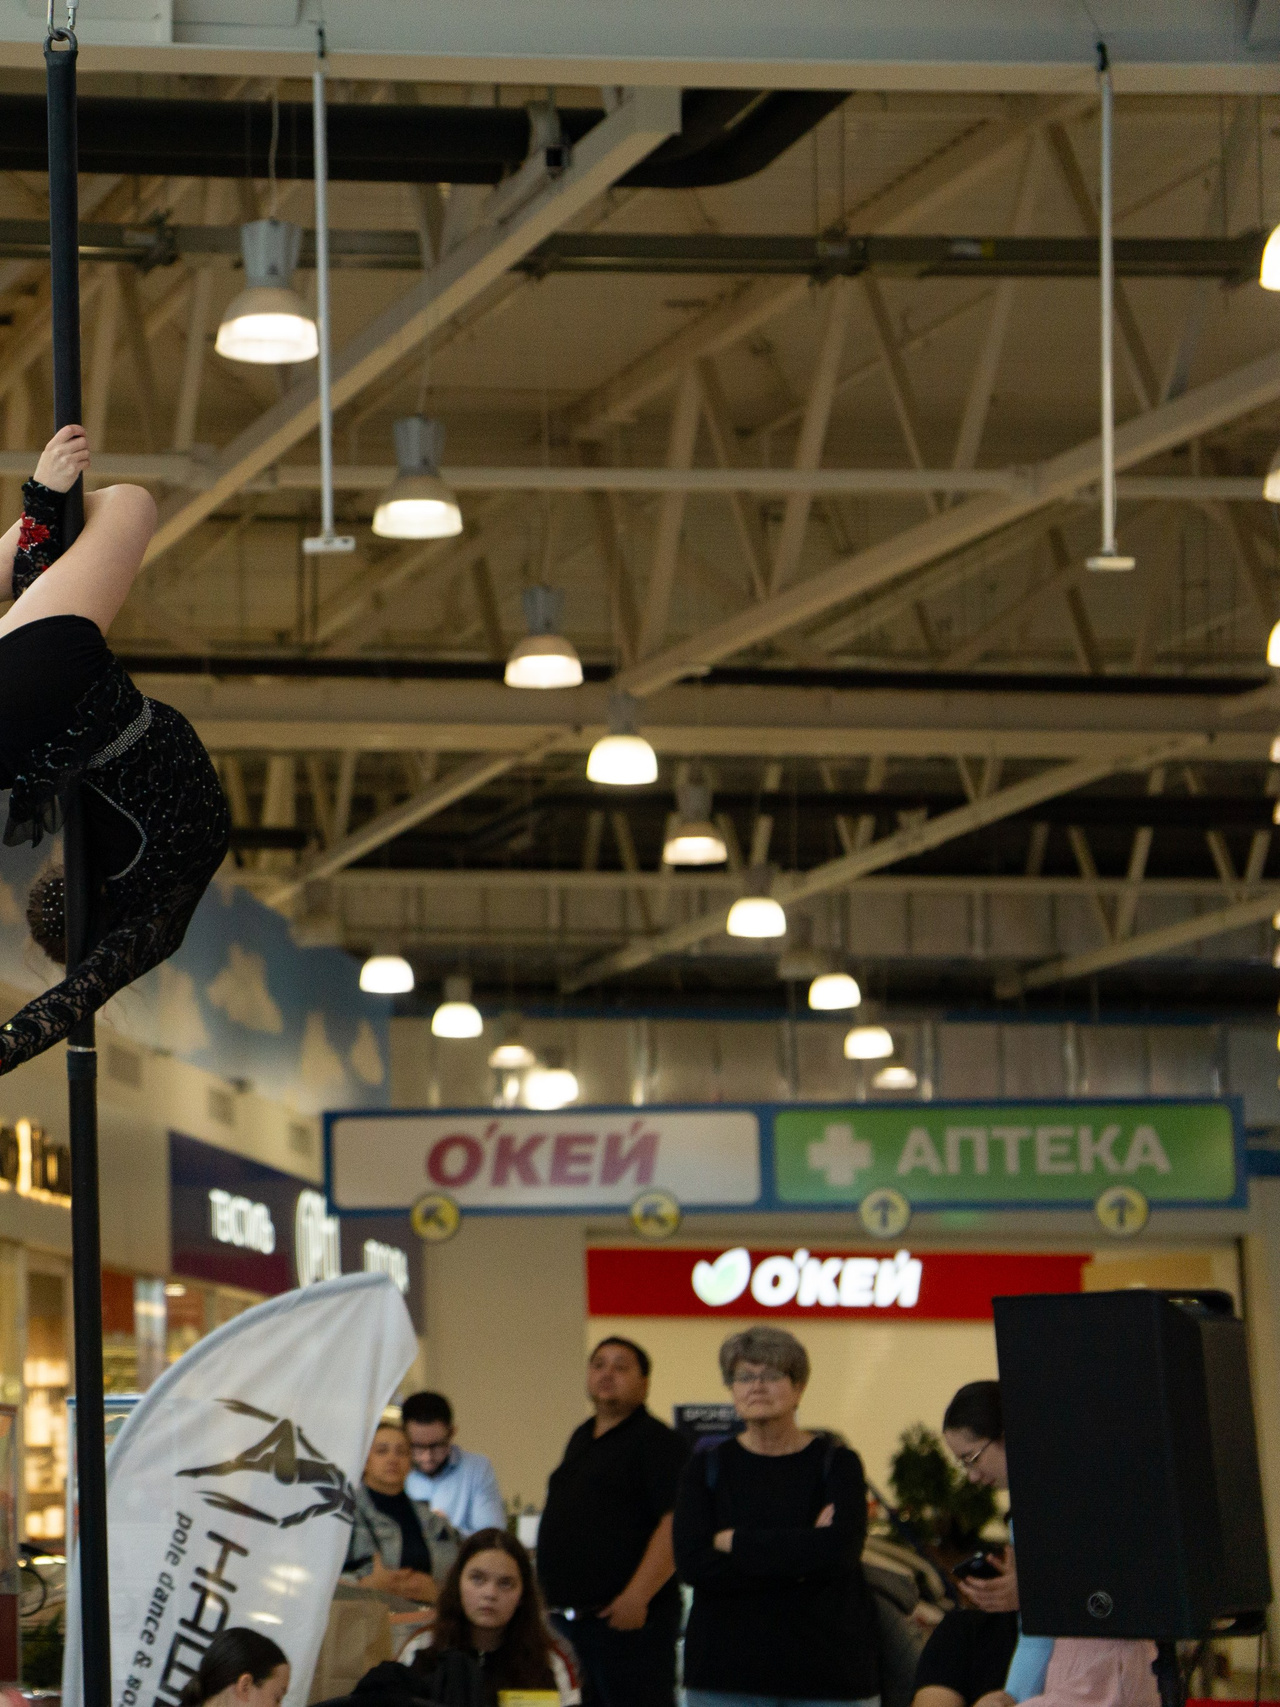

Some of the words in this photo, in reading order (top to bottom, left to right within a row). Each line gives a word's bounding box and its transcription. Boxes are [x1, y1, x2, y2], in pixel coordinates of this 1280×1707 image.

[896, 1124, 1171, 1176] АПТЕКА
[165, 1511, 194, 1567] pole
[140, 1571, 175, 1646] dance
[132, 1650, 153, 1669] &
[119, 1674, 143, 1707] so
